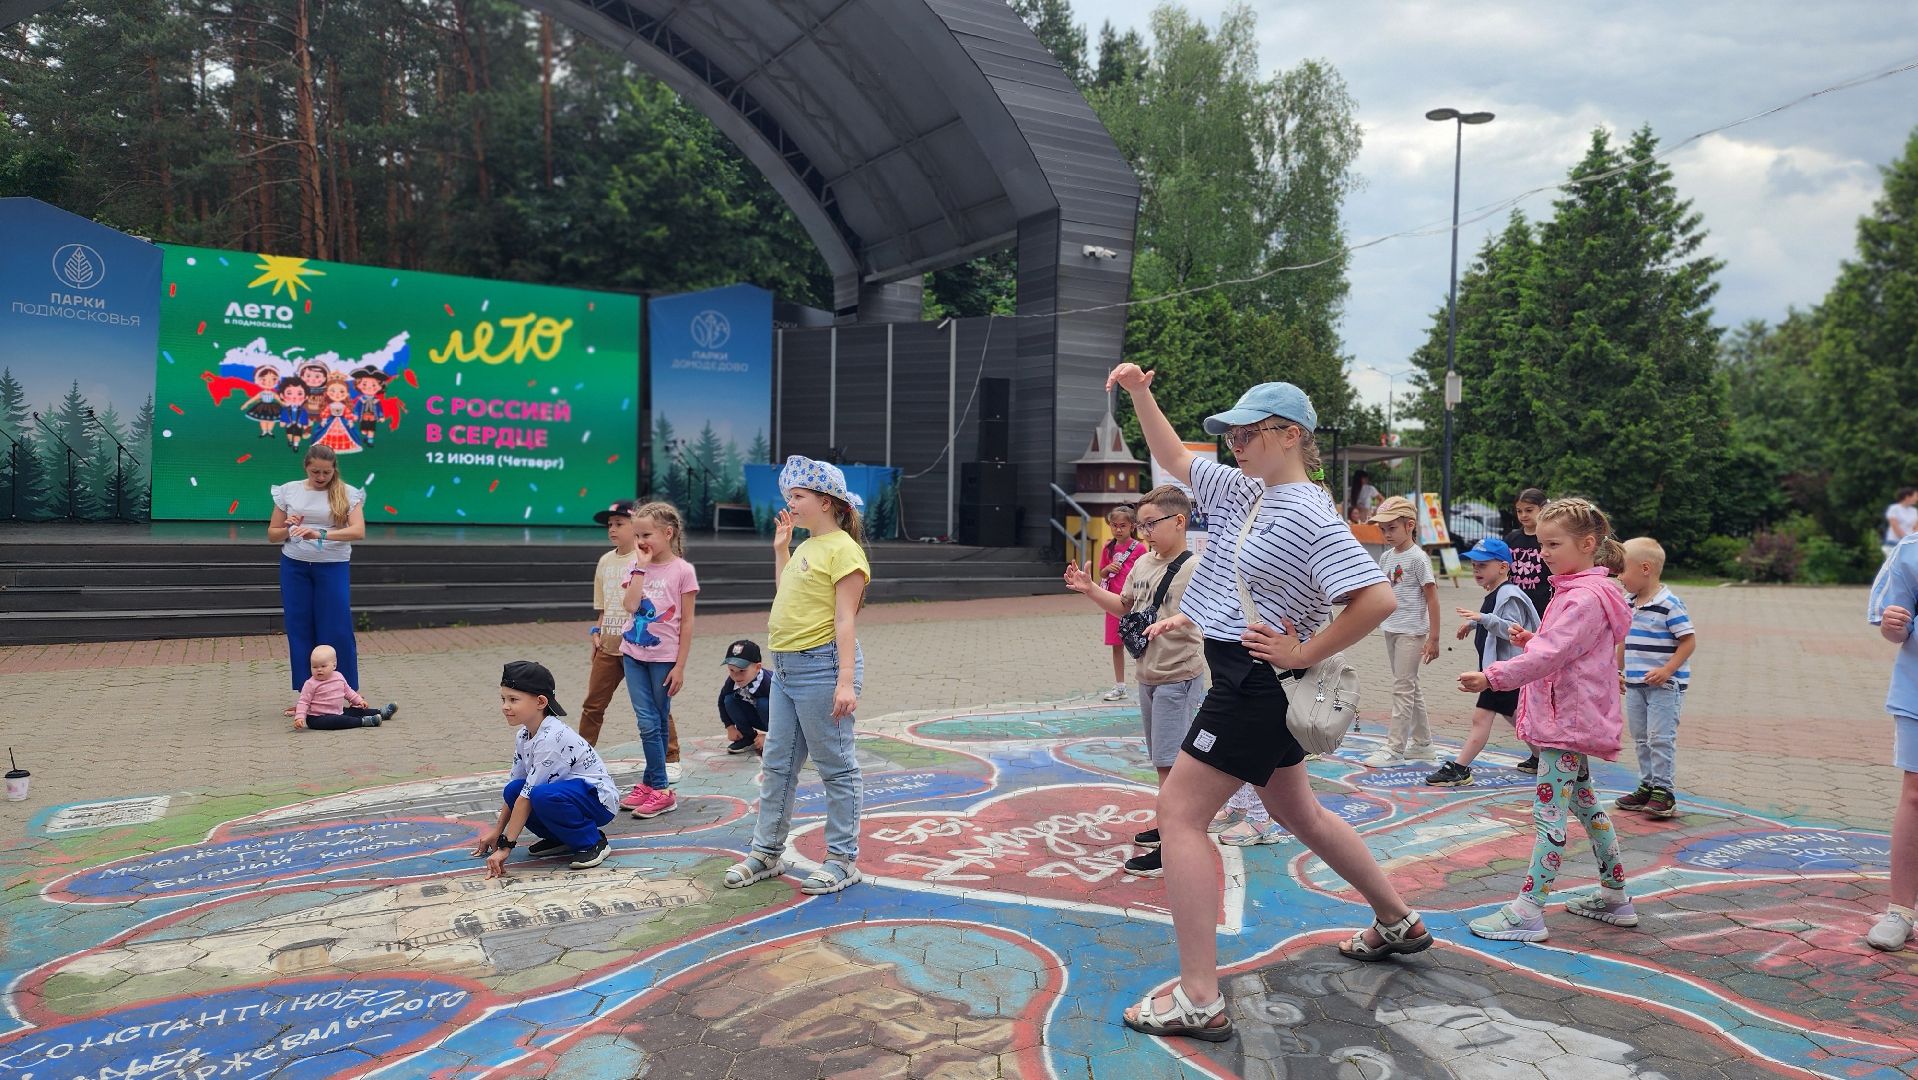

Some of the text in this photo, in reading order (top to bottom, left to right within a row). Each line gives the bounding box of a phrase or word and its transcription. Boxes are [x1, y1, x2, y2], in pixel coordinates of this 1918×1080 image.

[51, 292, 105, 309] ПАРКИ
[12, 301, 140, 327] ПОДМОСКОВЬЯ
[426, 395, 572, 422] С РОССИЕЙ
[426, 423, 548, 449] В СЕРДЦЕ
[425, 452, 565, 470] 12 ИЮНЯ (Четверг)
